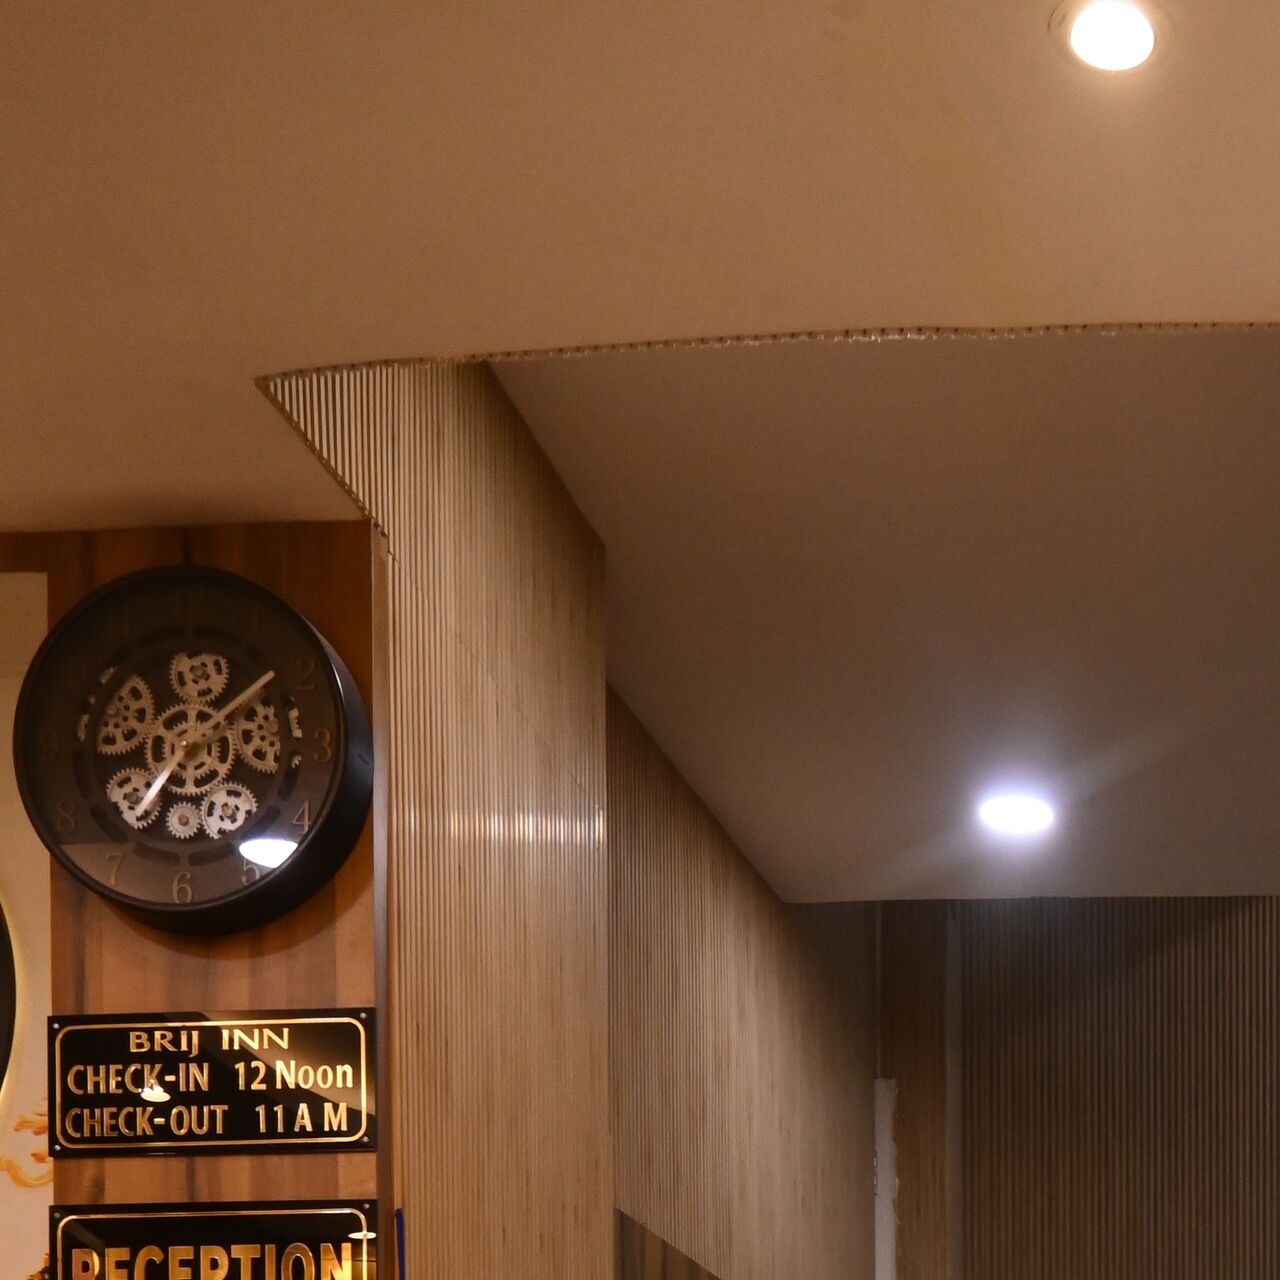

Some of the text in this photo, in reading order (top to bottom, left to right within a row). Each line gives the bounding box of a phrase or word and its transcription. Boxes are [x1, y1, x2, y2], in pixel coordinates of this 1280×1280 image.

[314, 730, 332, 762] 3
[56, 800, 77, 833] 8
[292, 800, 311, 834] 4
[105, 853, 126, 886] 7
[172, 872, 192, 904] 6
[129, 1028, 289, 1057] BRIJ INN
[67, 1060, 353, 1095] CHECK-IN 12 Noon
[65, 1104, 228, 1138] CHECK-OUT
